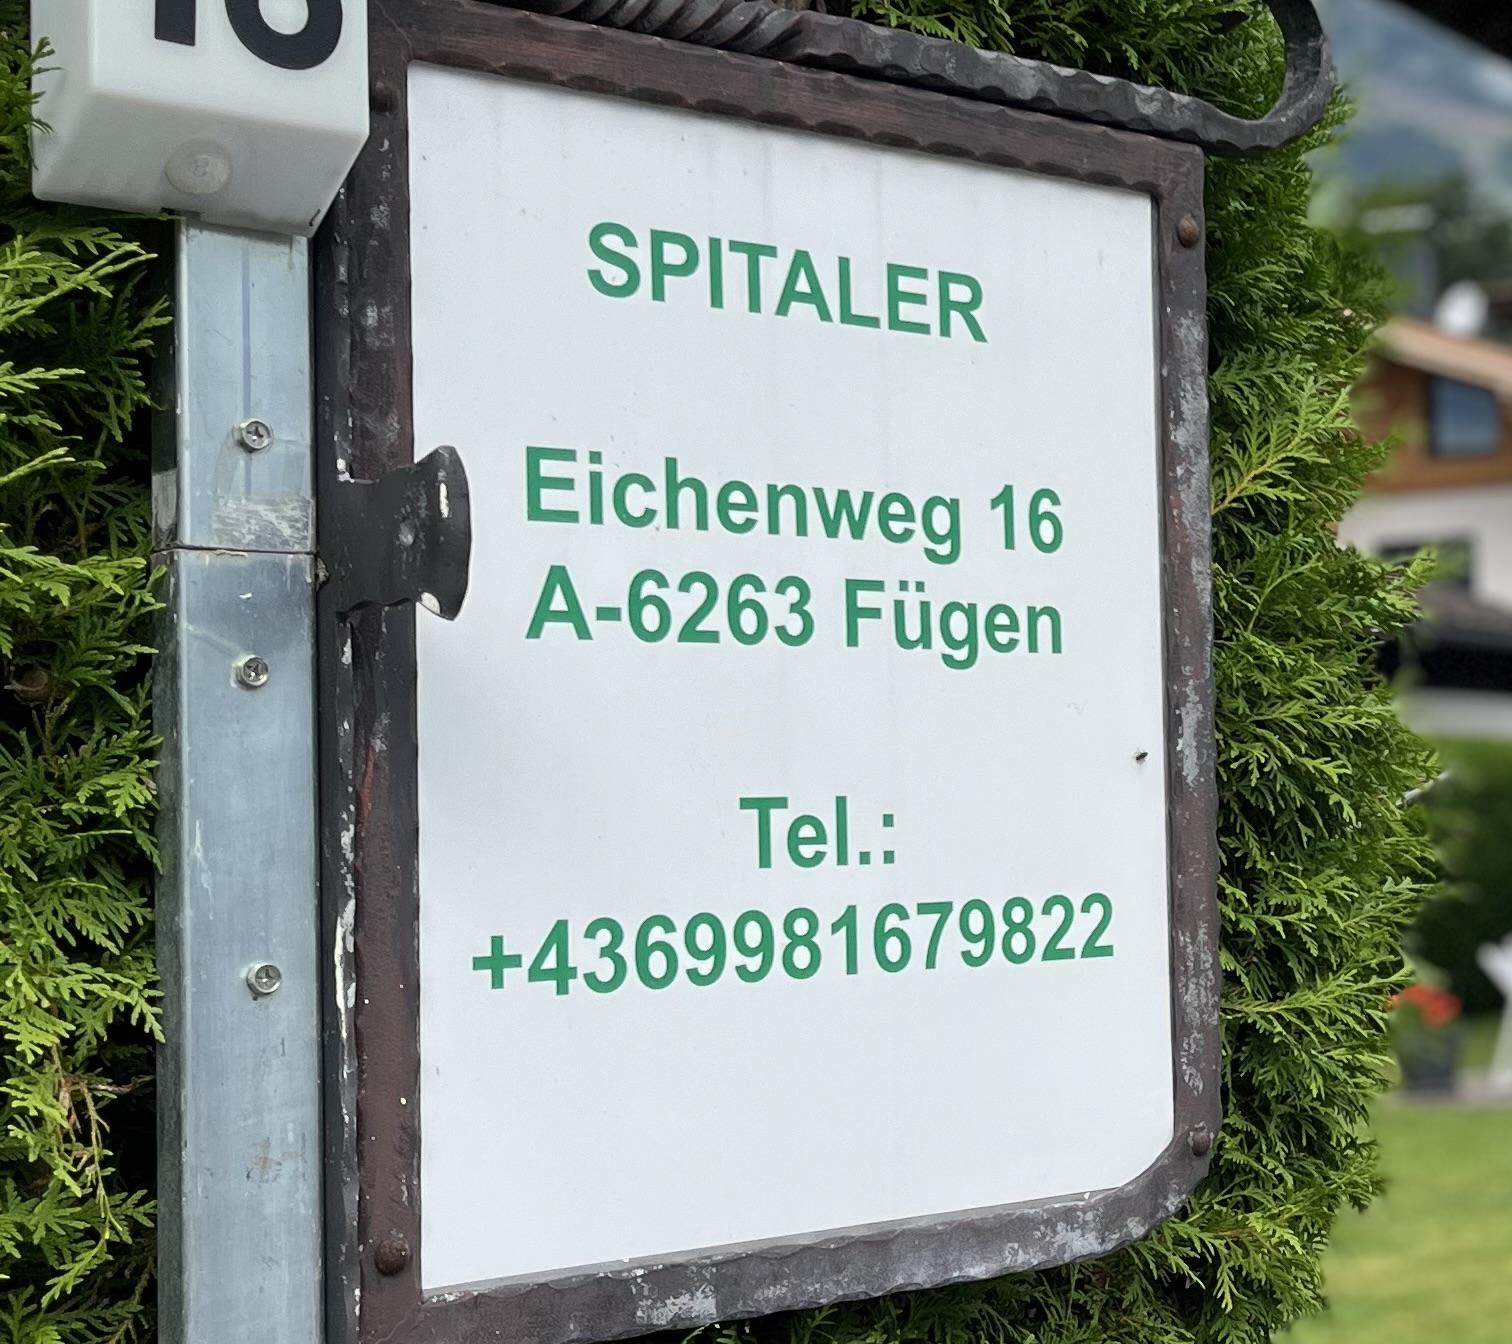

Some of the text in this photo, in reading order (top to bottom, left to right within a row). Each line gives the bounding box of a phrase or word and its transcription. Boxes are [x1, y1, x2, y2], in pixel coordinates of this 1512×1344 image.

[586, 221, 987, 343] SPITALER
[524, 445, 1064, 566] Eichenweg 16
[526, 564, 1063, 671] A-6263 Fügen
[737, 794, 897, 871] Tel.:
[471, 891, 1116, 998] +4369981679822
